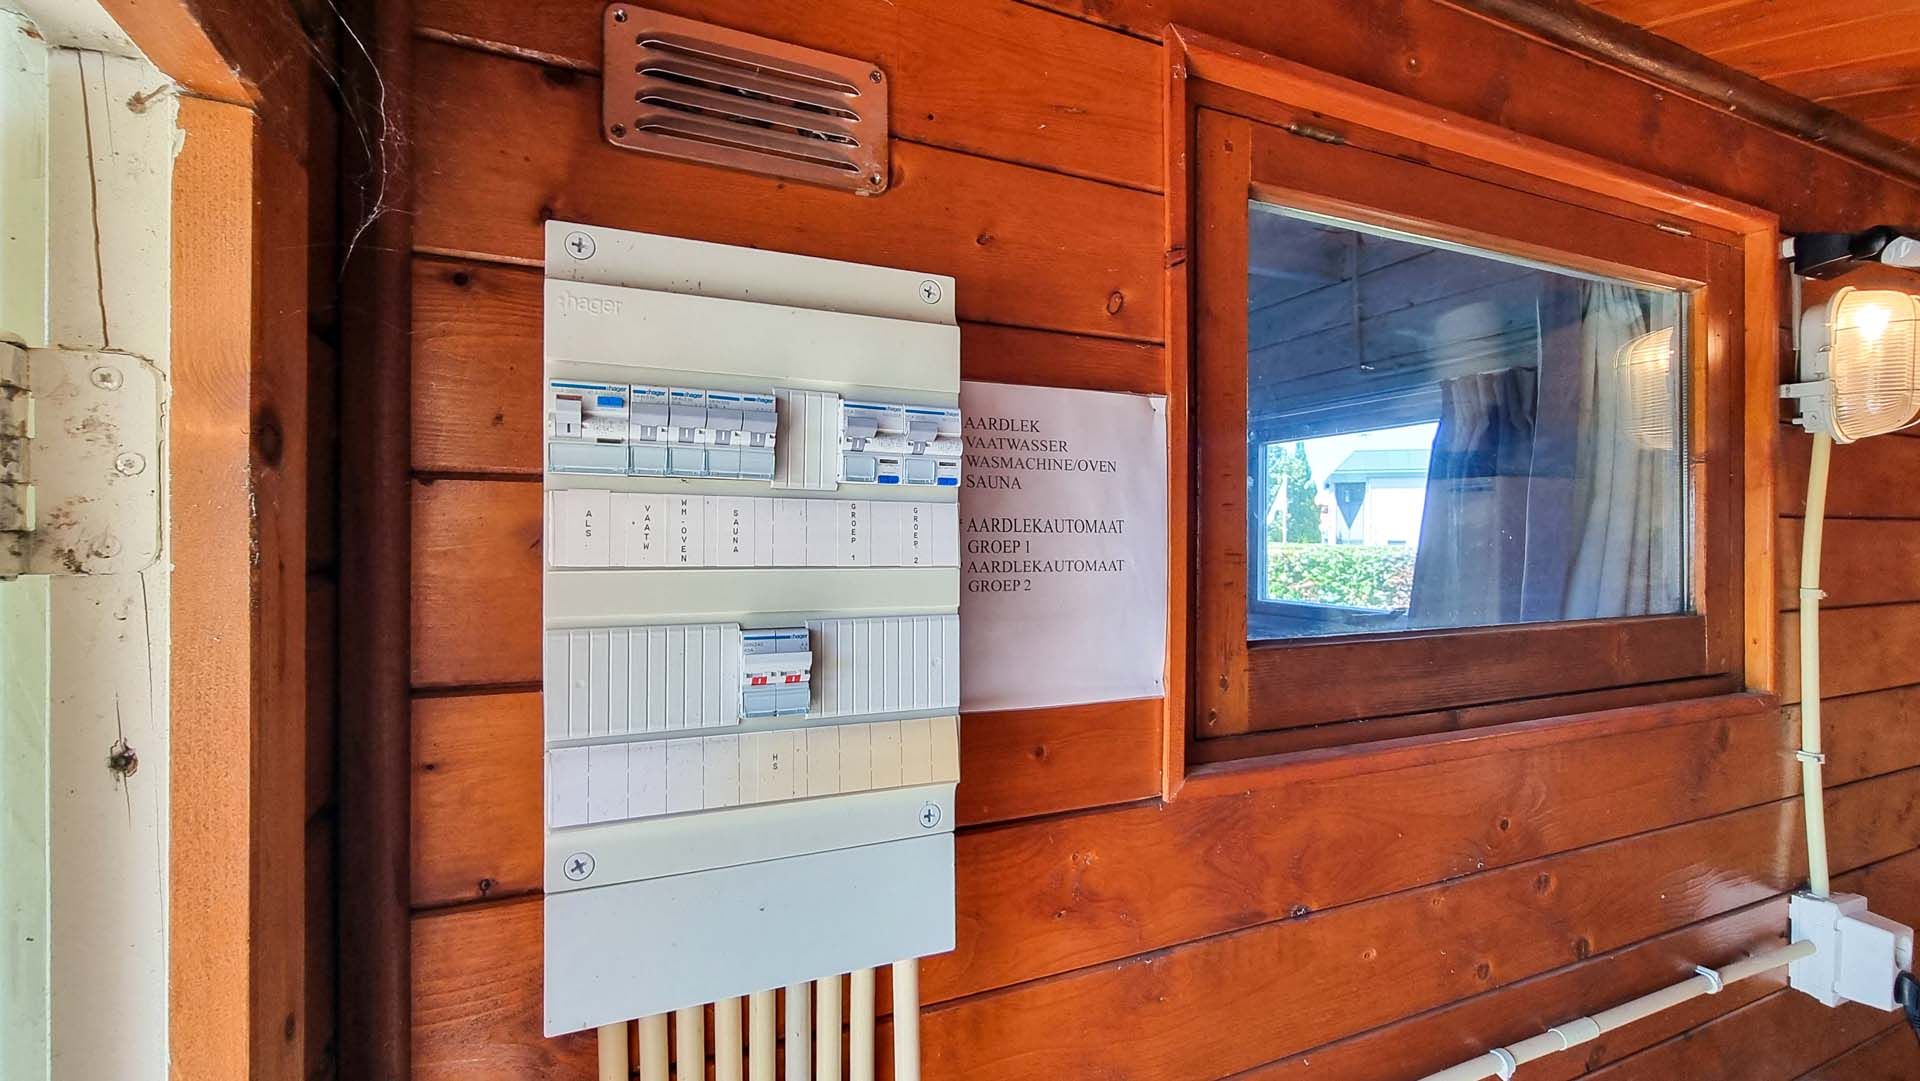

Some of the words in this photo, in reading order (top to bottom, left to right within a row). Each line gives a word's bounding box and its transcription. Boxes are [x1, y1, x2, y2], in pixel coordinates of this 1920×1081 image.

[563, 290, 623, 317] hager
[964, 416, 1040, 433] AARDLEK
[966, 436, 1069, 453] VAATWASSER
[966, 455, 1117, 473] WASMACHINE/OVEN
[966, 475, 1022, 490] SAUNA
[643, 505, 651, 550] VAATW
[967, 517, 1124, 534] AARDLEKAUTOMAAT
[968, 540, 1021, 554] GROEP
[1025, 540, 1030, 553] 1
[968, 559, 1125, 574] AARDLEKAUTOMAAT
[968, 580, 1021, 593] GROEP
[1024, 579, 1032, 591] 2
[772, 753, 778, 770] HS
